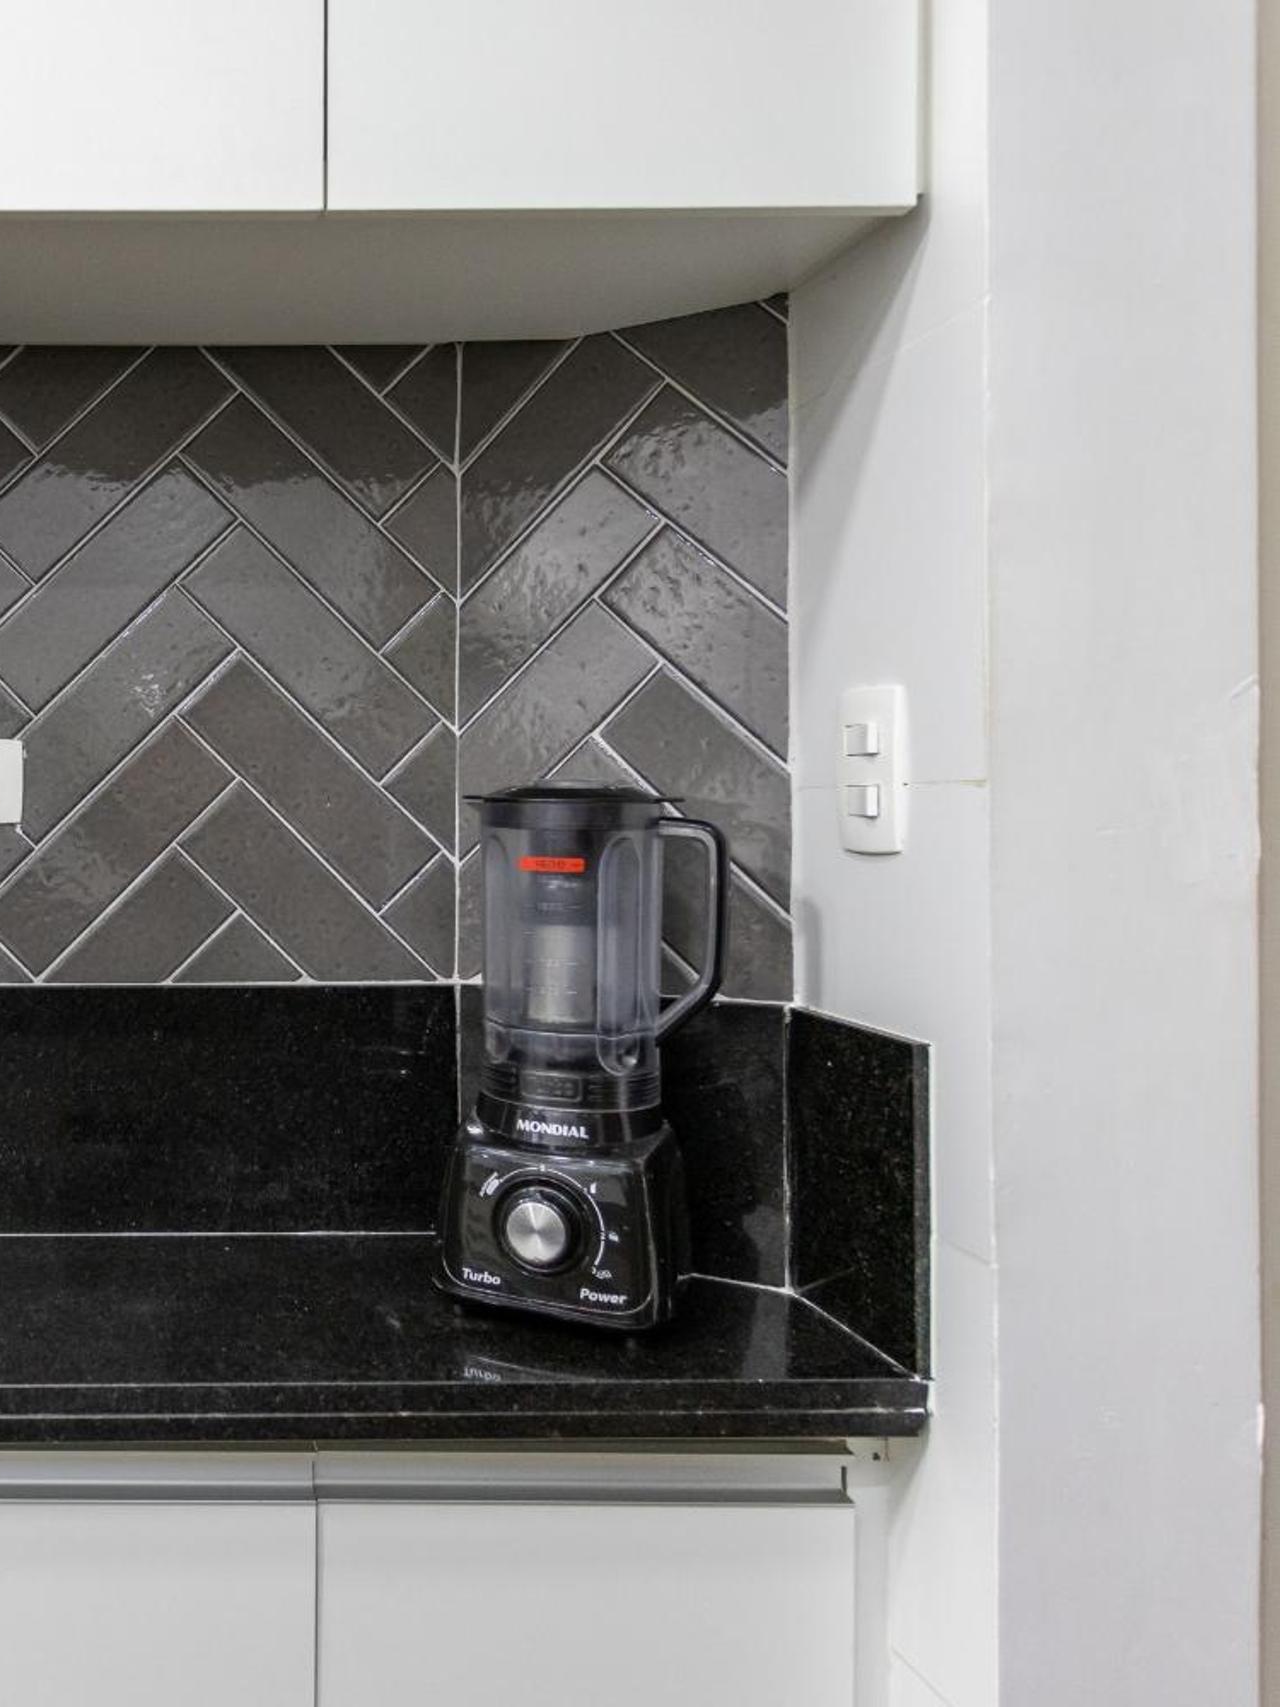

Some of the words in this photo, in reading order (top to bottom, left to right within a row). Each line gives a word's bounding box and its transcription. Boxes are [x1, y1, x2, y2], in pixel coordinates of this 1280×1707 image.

[516, 1118, 589, 1139] MONDIAL
[462, 1267, 501, 1285] Turbo
[579, 1287, 628, 1305] Power
